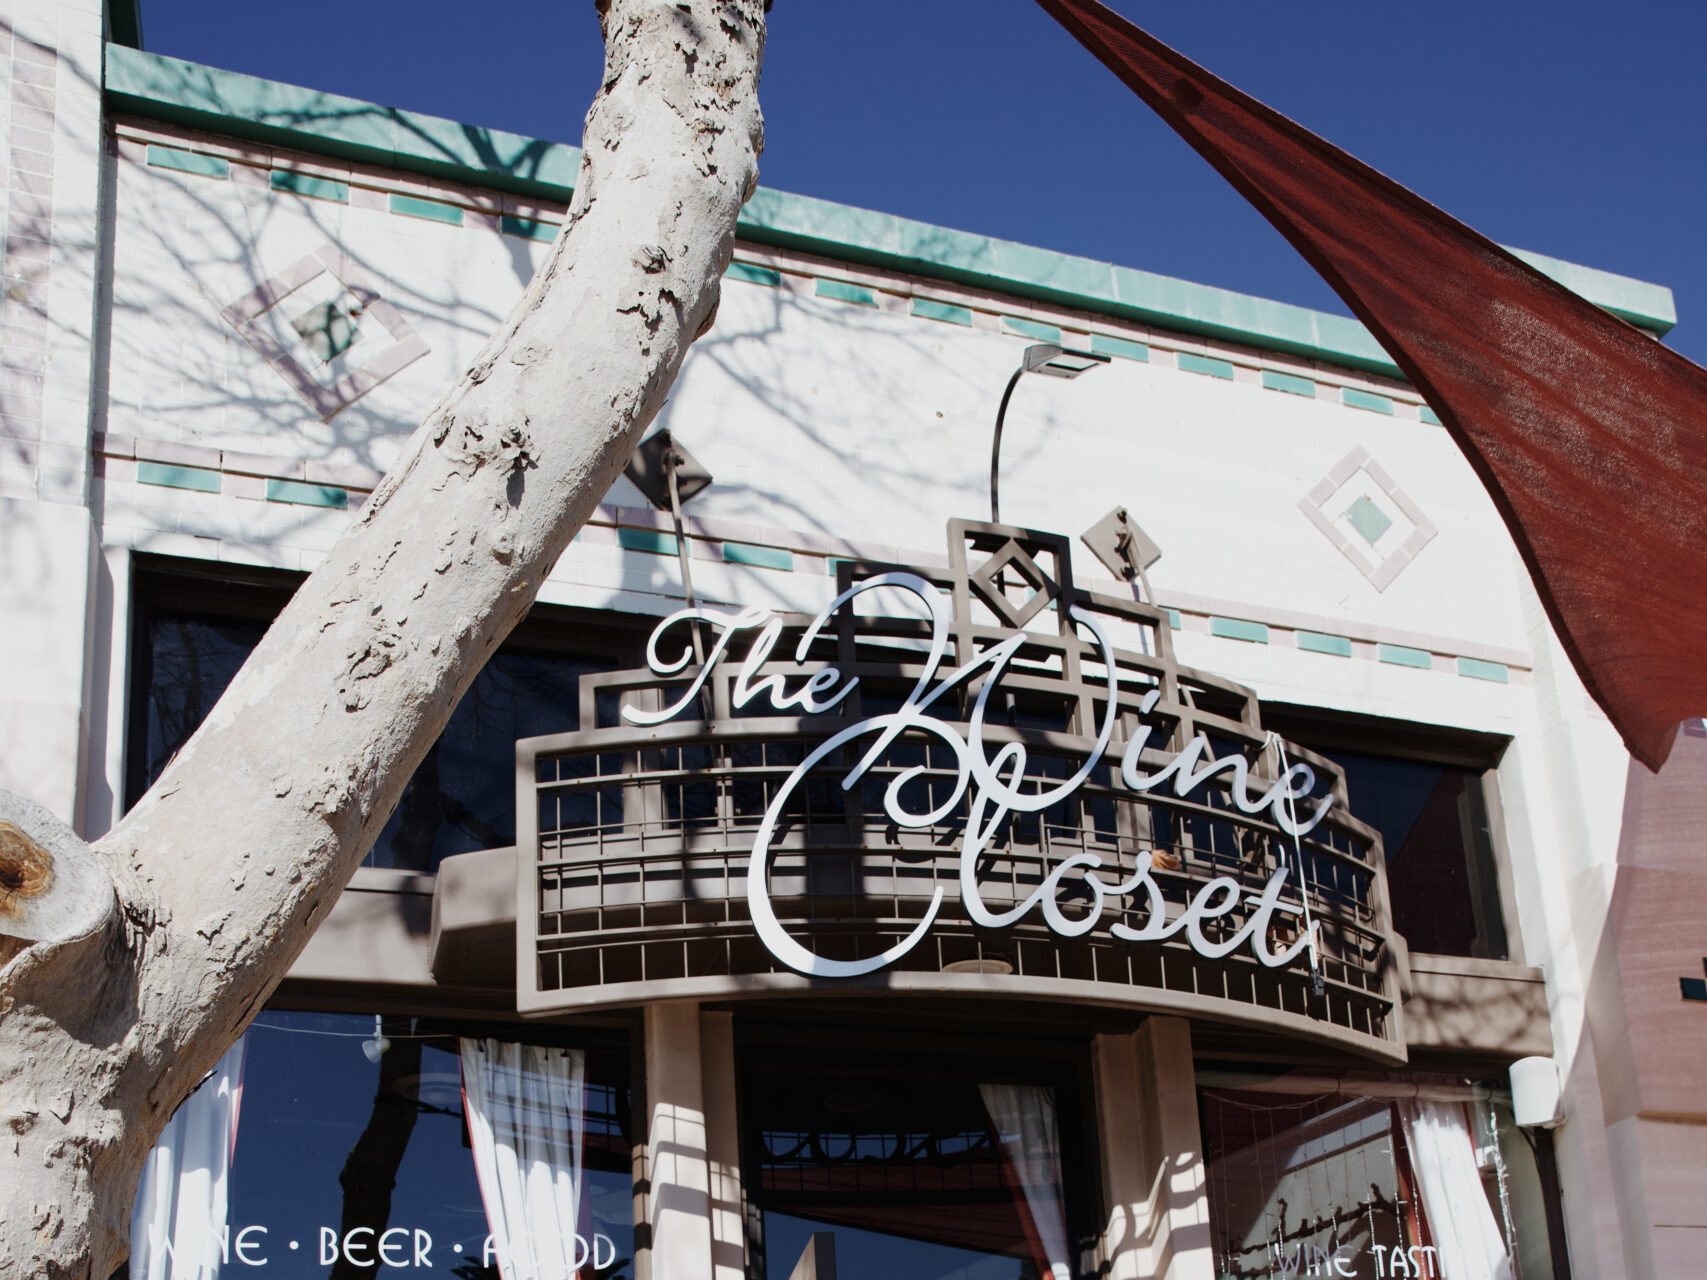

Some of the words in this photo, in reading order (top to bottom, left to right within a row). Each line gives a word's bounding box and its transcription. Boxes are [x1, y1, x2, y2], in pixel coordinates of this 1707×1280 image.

[621, 606, 859, 727] The
[796, 571, 1335, 837] Wine
[747, 715, 1320, 978] Closet
[319, 1226, 433, 1268] BEER
[1274, 1243, 1358, 1278] WINE
